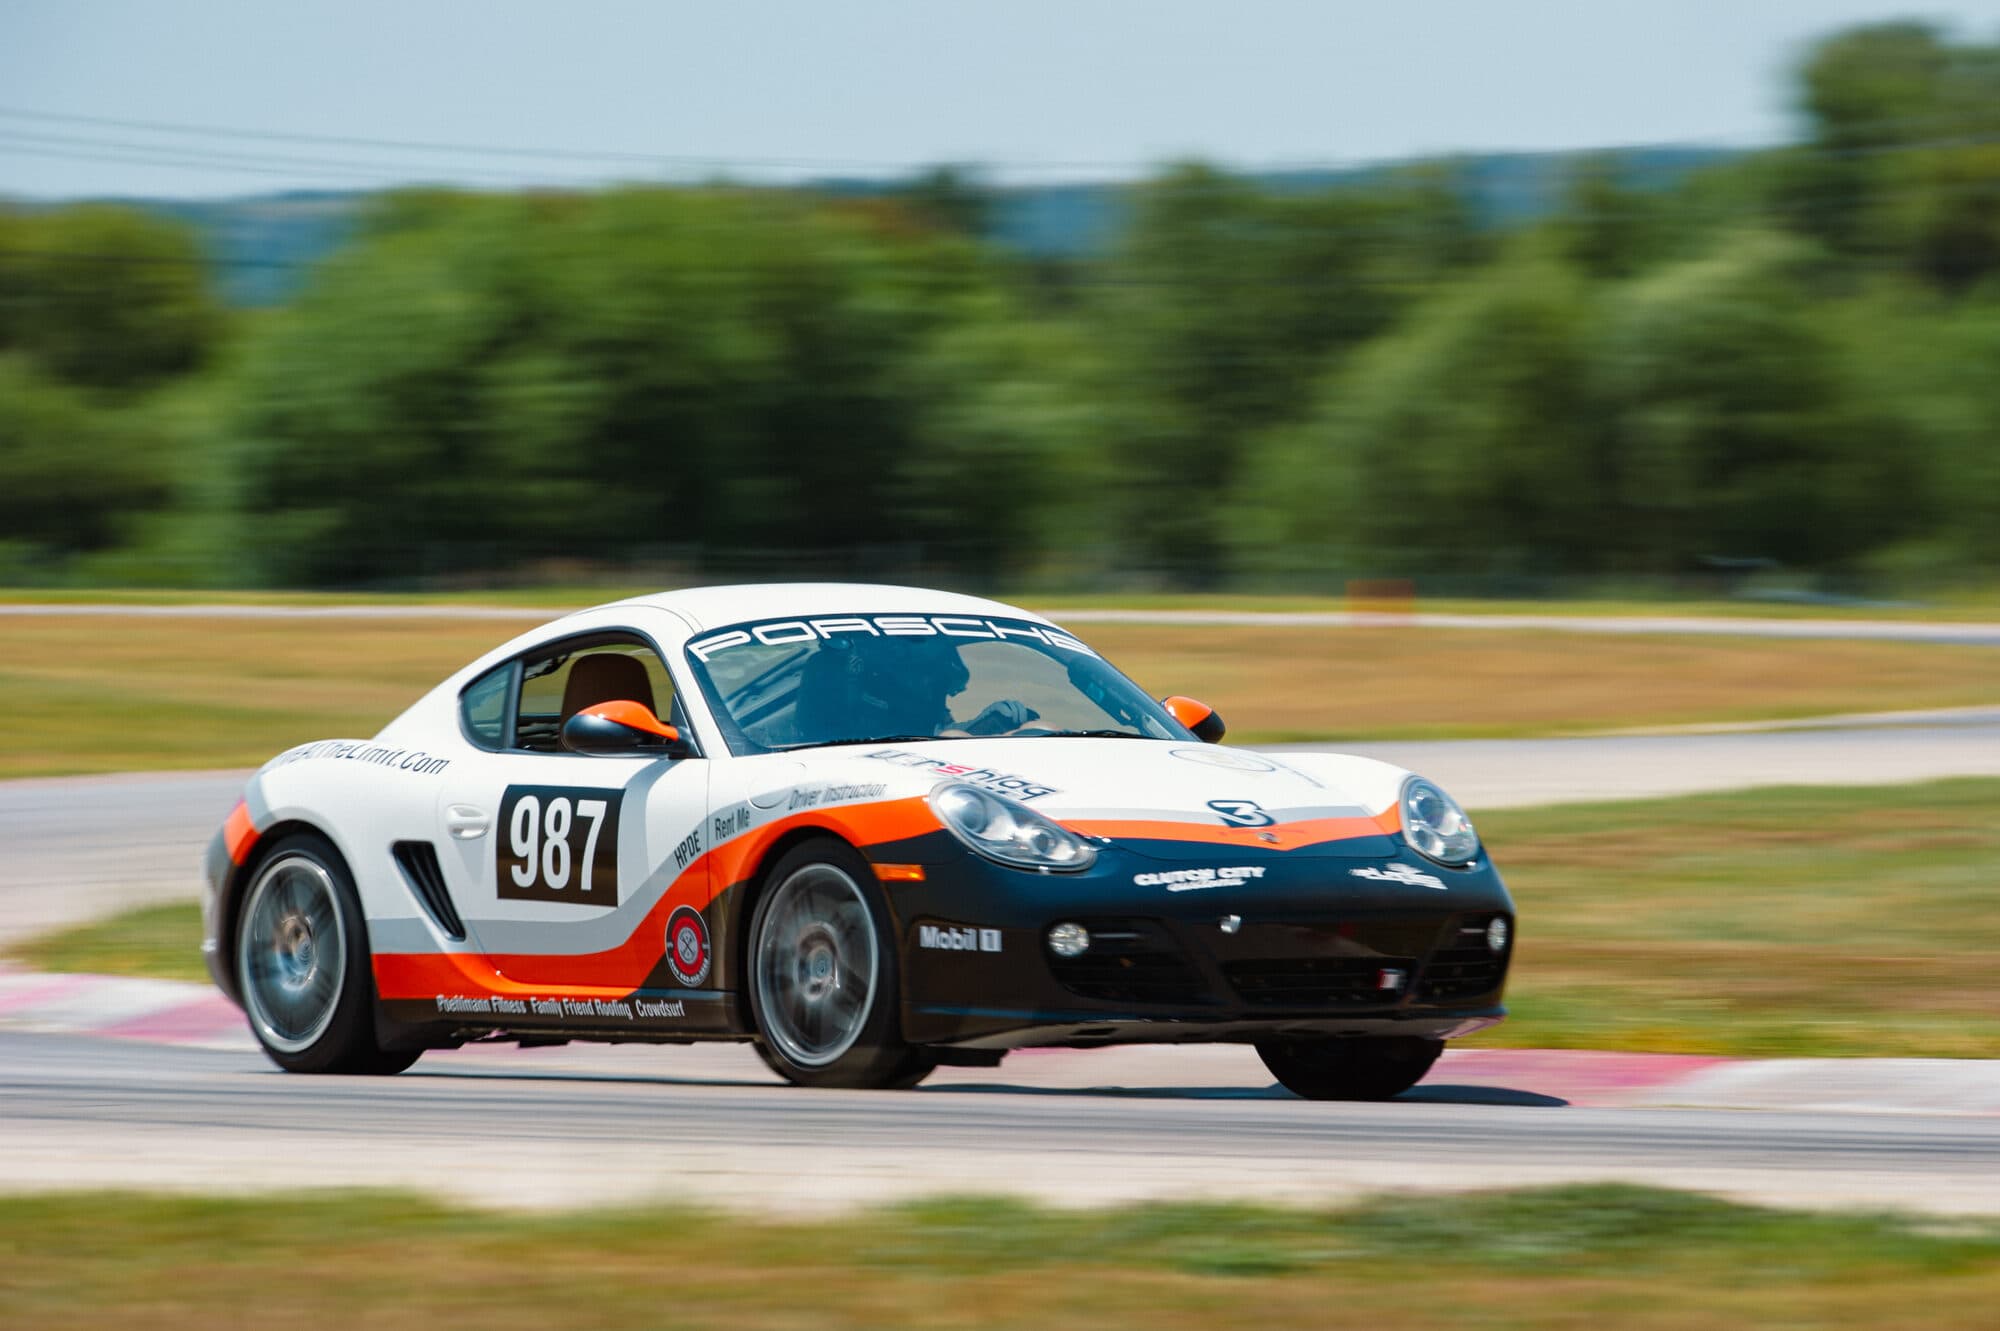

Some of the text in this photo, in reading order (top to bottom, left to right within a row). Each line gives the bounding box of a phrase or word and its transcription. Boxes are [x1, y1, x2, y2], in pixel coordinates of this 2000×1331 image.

[688, 616, 1101, 663] PORSCHE
[714, 807, 750, 840] Rent Me
[510, 795, 608, 891] 987
[673, 830, 702, 869] HPDE
[919, 925, 978, 951] Mobil
[529, 996, 564, 1018] Family
[563, 998, 594, 1017] Friend
[595, 997, 634, 1020] Roofing
[635, 998, 686, 1018] Crowdsurf
